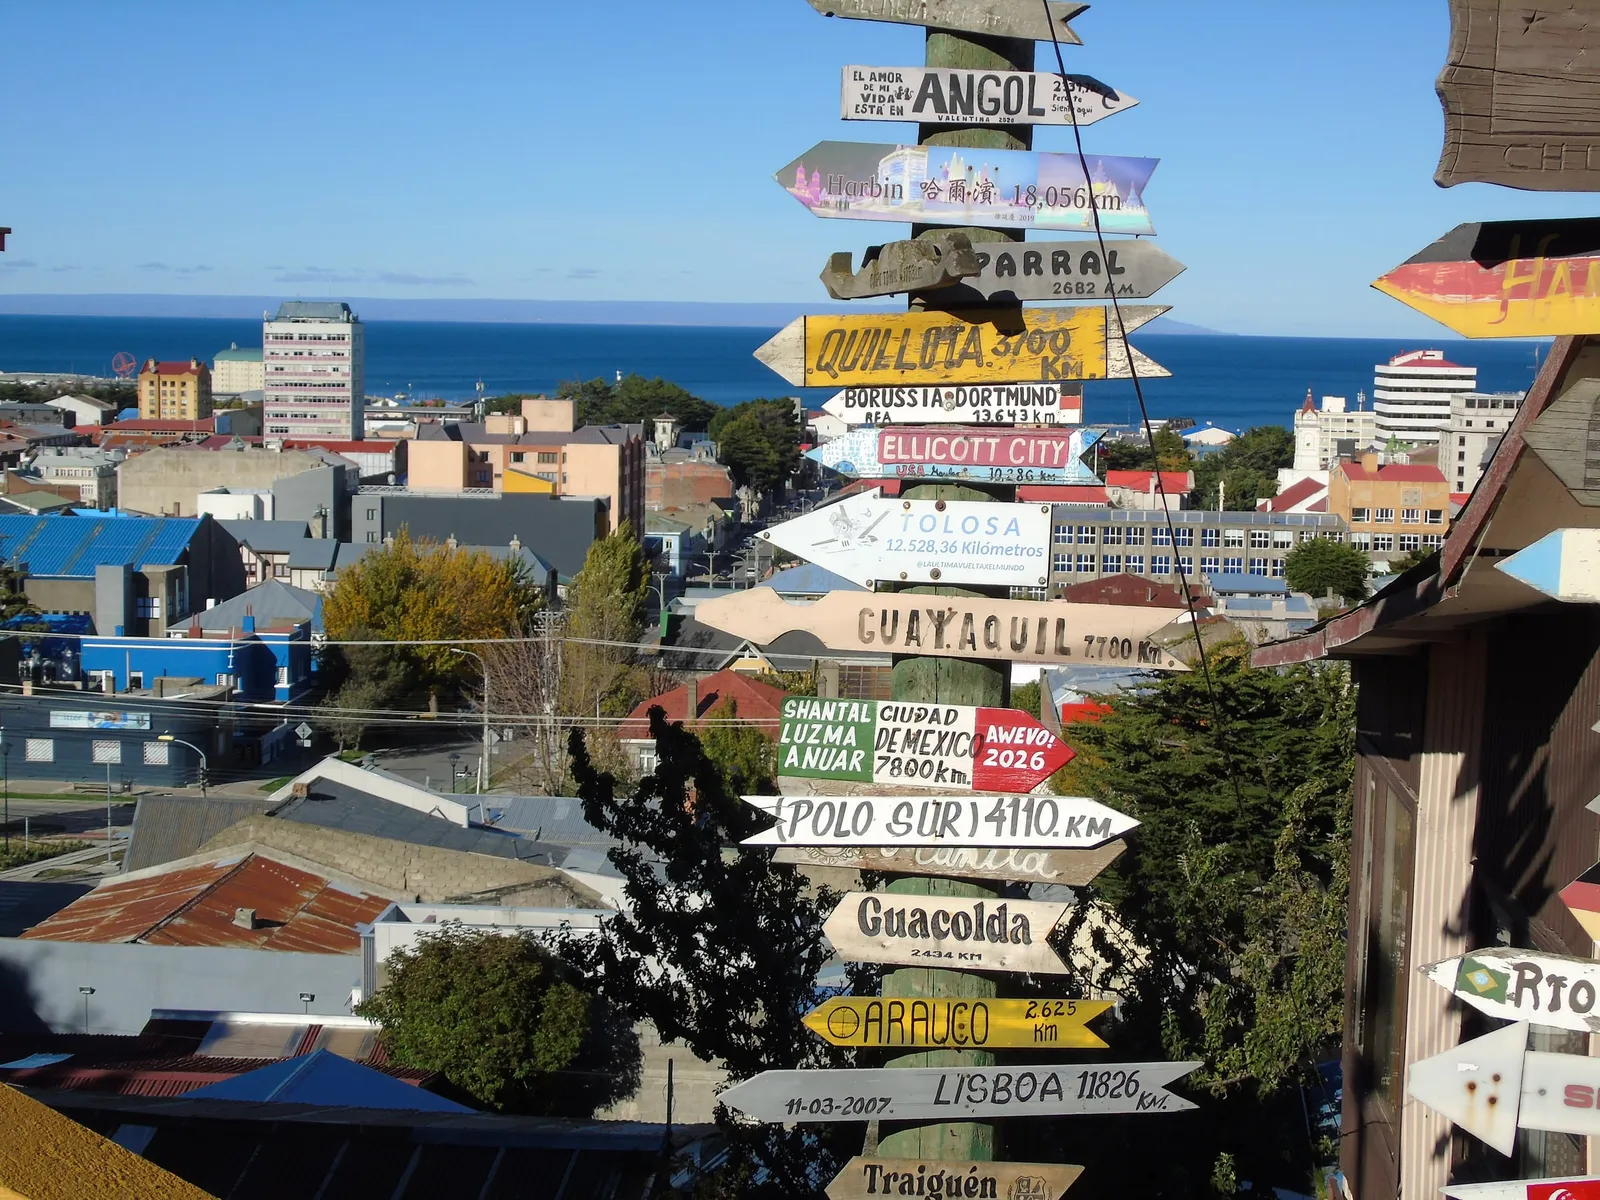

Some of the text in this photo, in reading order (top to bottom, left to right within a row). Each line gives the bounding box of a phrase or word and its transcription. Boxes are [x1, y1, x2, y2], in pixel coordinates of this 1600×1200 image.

[853, 70, 903, 84] EL AMOR
[863, 83, 890, 93] DE MI
[860, 93, 895, 104] VIDA
[912, 72, 1046, 117] ANGOL
[889, 105, 904, 116] EN
[937, 114, 991, 123] VALENTINA
[1051, 103, 1075, 113] Sient
[826, 173, 904, 200] Harbin
[919, 177, 996, 205] 哈爾濱
[1018, 214, 1036, 222] 2019
[974, 250, 1126, 276] PARRAL
[1501, 232, 1600, 305] HA
[1052, 281, 1096, 295] 2682
[844, 387, 1058, 409] BORUSSIA DORTMUND
[865, 411, 892, 422] RFA
[882, 436, 1001, 462] ELLICOTT
[1008, 437, 1066, 466] CITY
[896, 464, 925, 478] USA
[902, 513, 1022, 537] TOLOSA
[885, 538, 1044, 558] 12.528,36 Kilómetros
[916, 560, 1025, 572] @LAULTIMAVUELTAXELMUNDO
[857, 607, 1072, 656] GUAYAQUIL
[783, 699, 872, 723] SHANTAL
[879, 705, 959, 726] CIUDAD
[780, 724, 857, 747] LUZMA
[986, 725, 1056, 749] AWEVO!
[784, 745, 866, 773] ANUAR
[983, 748, 1046, 771] 2026
[857, 896, 1033, 946] Guacolda
[911, 948, 983, 961] 2434 KM
[863, 1001, 989, 1046] ARAUCO
[933, 1072, 1064, 1106] LISBOA
[1563, 1083, 1600, 1110] S
[864, 1164, 998, 1200] Traiguén
